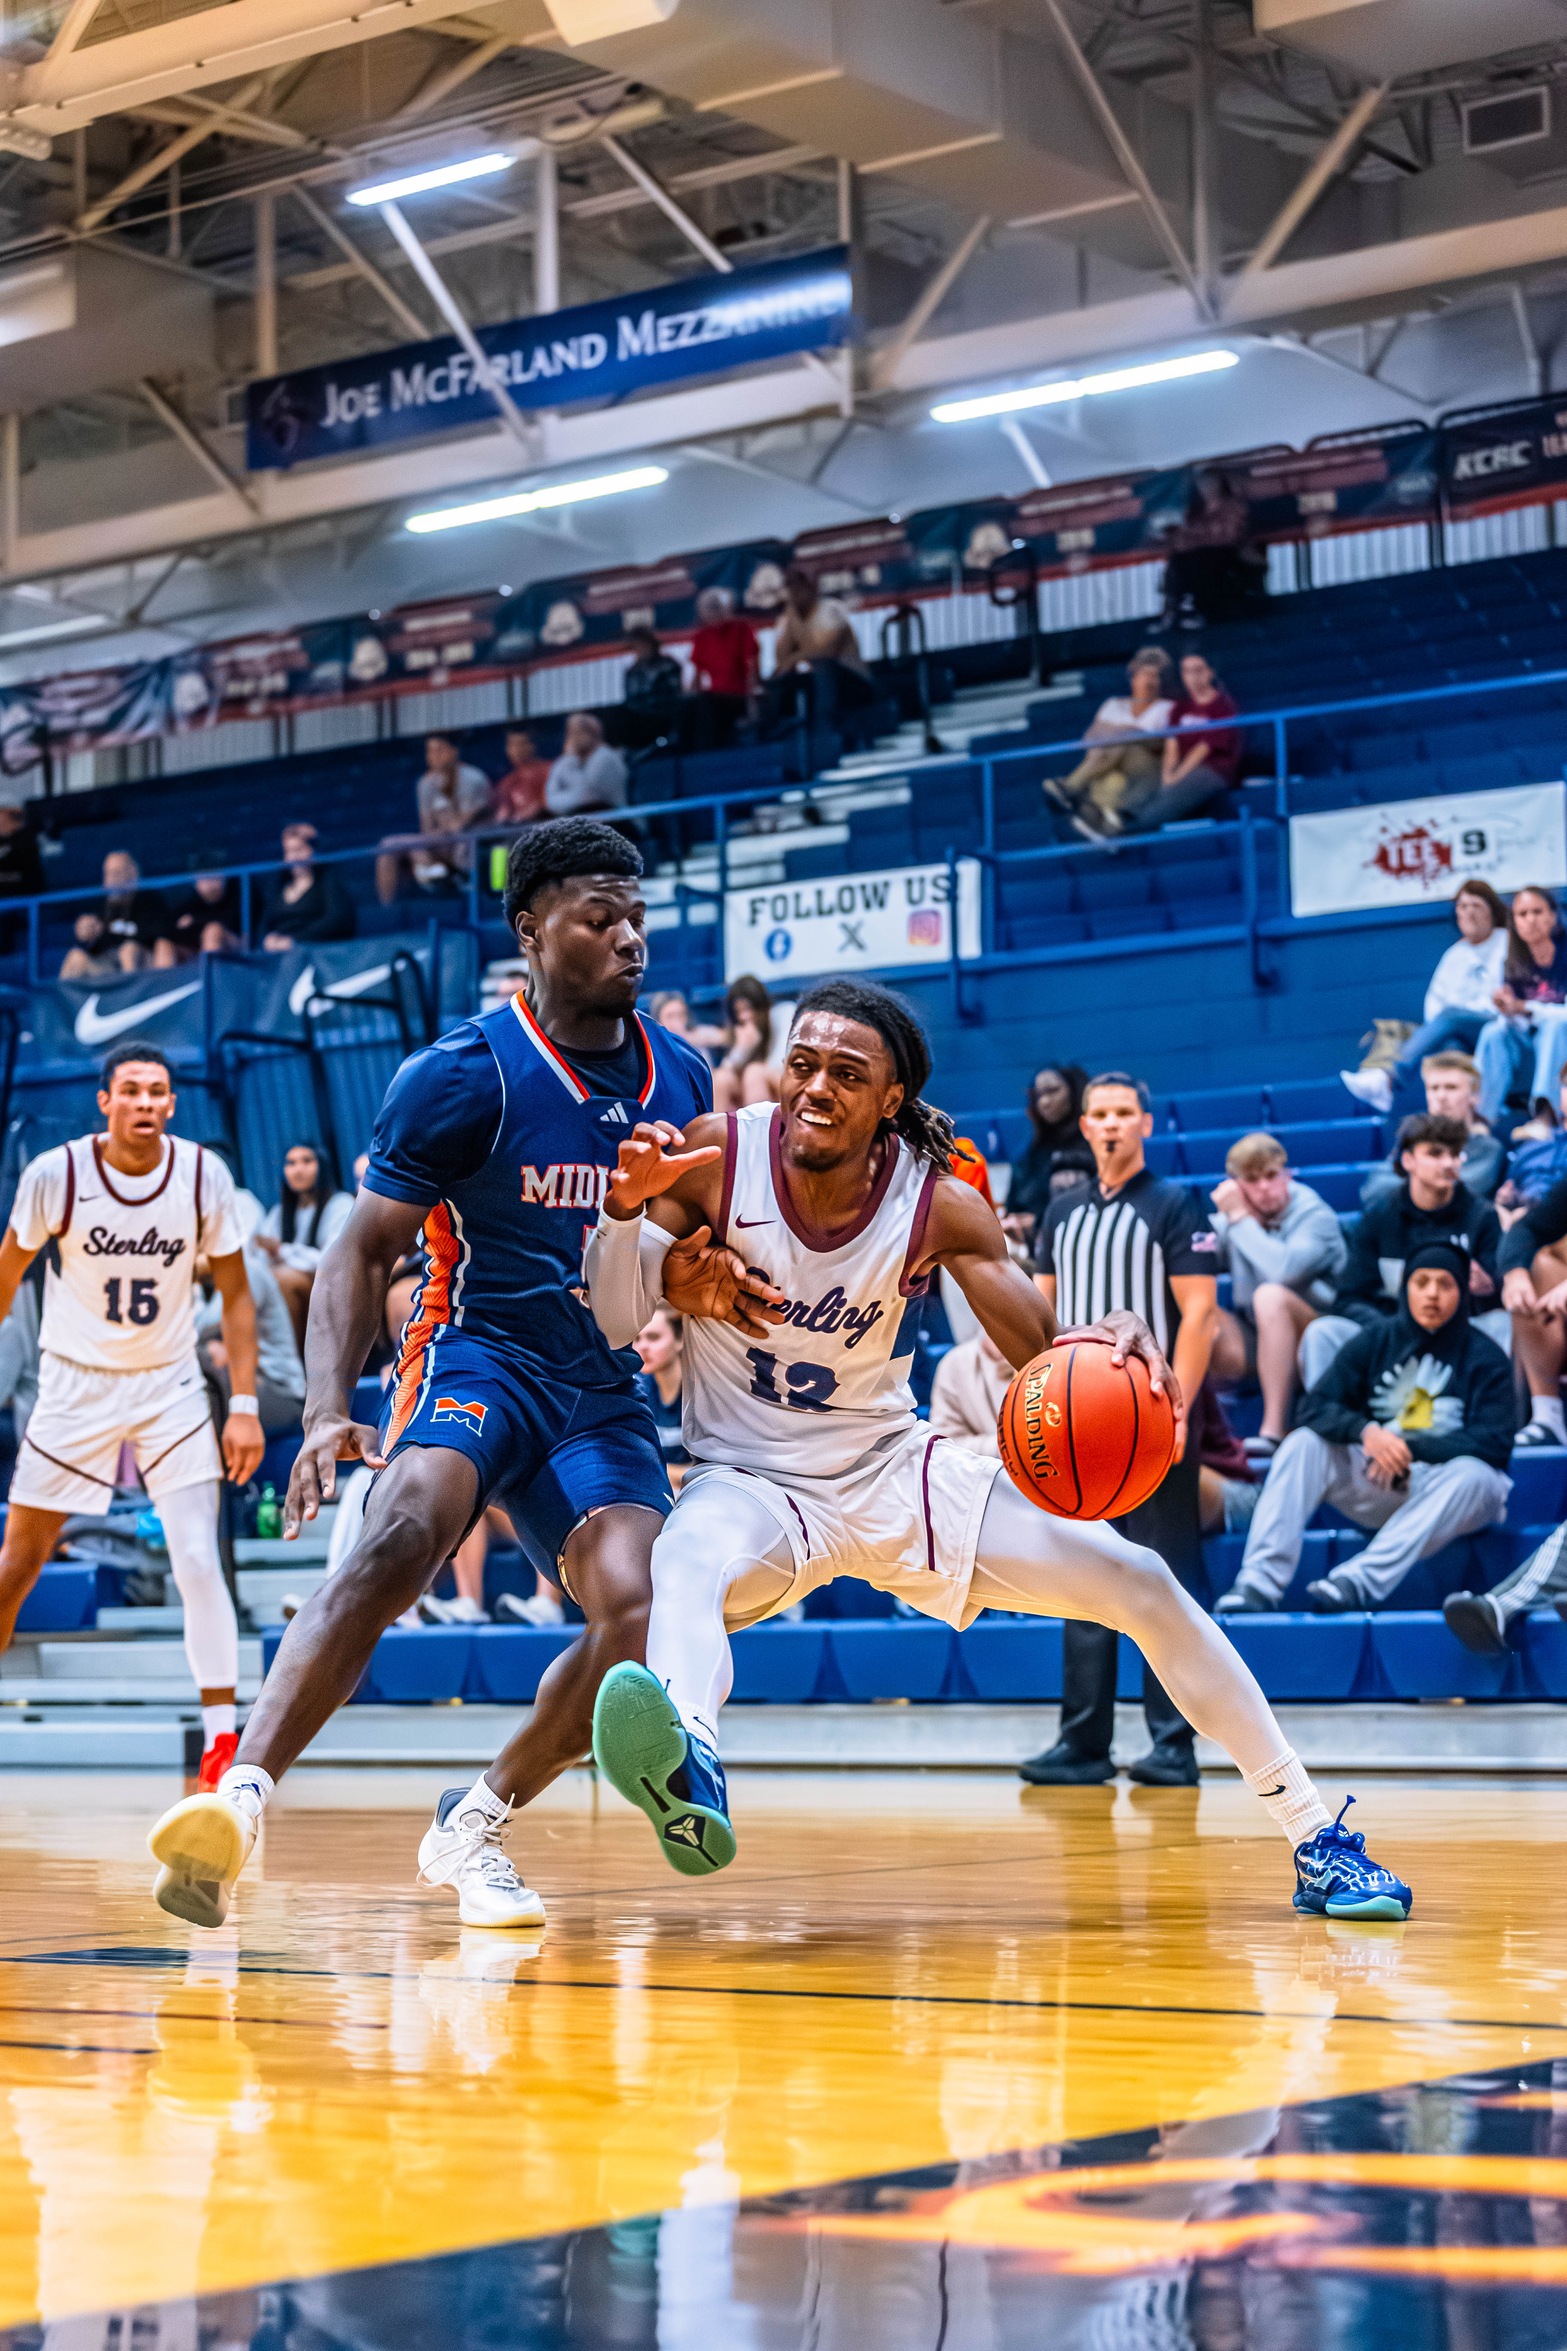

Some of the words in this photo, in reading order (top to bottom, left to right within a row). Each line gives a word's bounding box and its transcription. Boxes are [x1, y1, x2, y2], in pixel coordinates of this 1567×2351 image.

[321, 382, 380, 427] JOE
[749, 880, 891, 928] FOLLOW
[906, 874, 951, 907] US
[83, 1226, 186, 1267] Sterling
[104, 1278, 159, 1325] 15
[746, 1266, 884, 1349] erling
[746, 1347, 841, 1412] 12
[1024, 1362, 1060, 1479] SPALDING
